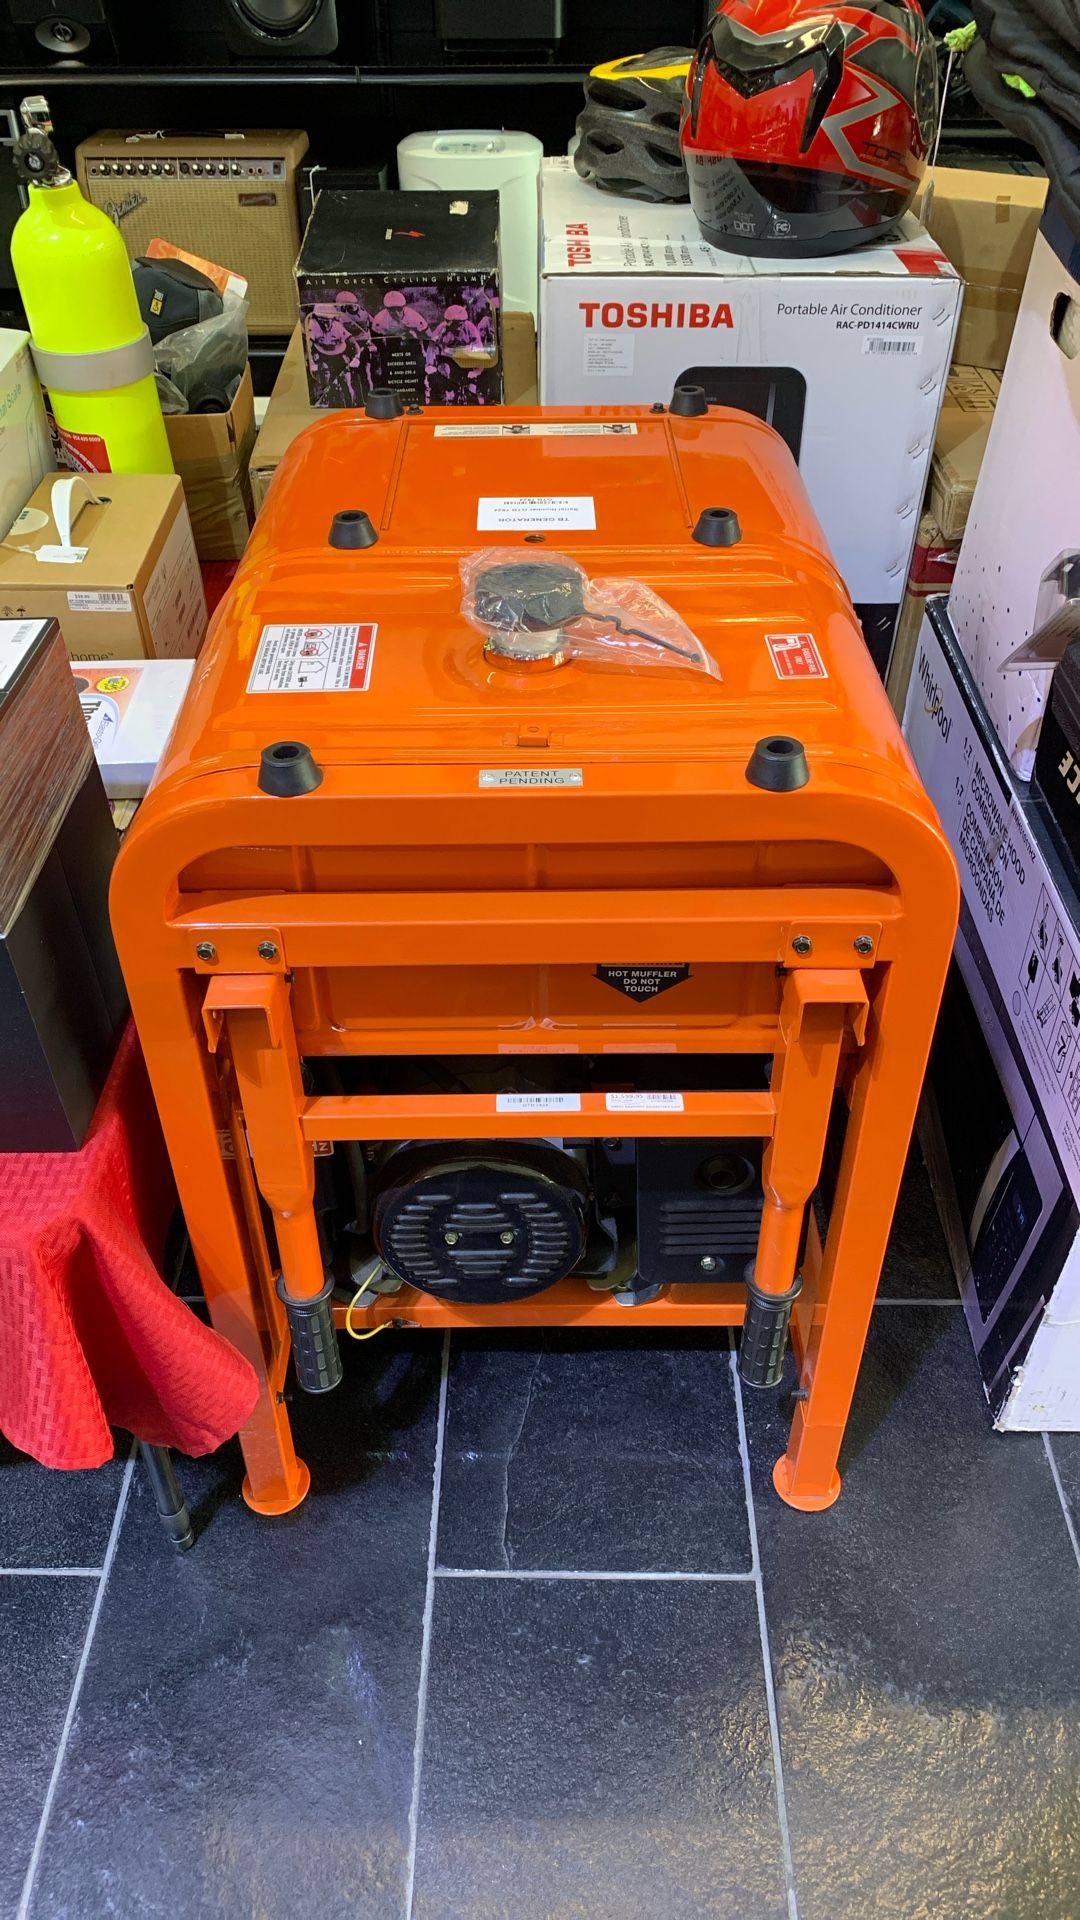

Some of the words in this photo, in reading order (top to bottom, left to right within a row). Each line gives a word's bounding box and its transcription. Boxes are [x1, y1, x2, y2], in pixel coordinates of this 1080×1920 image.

[733, 220, 756, 232] DOT
[565, 223, 592, 267] TOSHBA
[335, 277, 374, 285] FORCE
[383, 275, 437, 284] CYCLING
[578, 303, 734, 328] TOSHIBA
[777, 303, 828, 315] Portable
[830, 303, 848, 315] Air
[850, 303, 923, 316] Conditioner
[836, 321, 920, 330] RAC-PD1414CWRU
[355, 649, 367, 670] DANGER
[919, 646, 952, 743] Whirlpool
[499, 777, 565, 785] PENDING
[974, 762, 1008, 842] MICROWAVE
[1007, 837, 1026, 885] HOOD
[958, 832, 994, 924] MICROONDAS
[961, 816, 972, 839] DE
[969, 837, 997, 903] CAMPANA
[994, 899, 1006, 927] DE
[631, 970, 677, 978] MUFFLER
